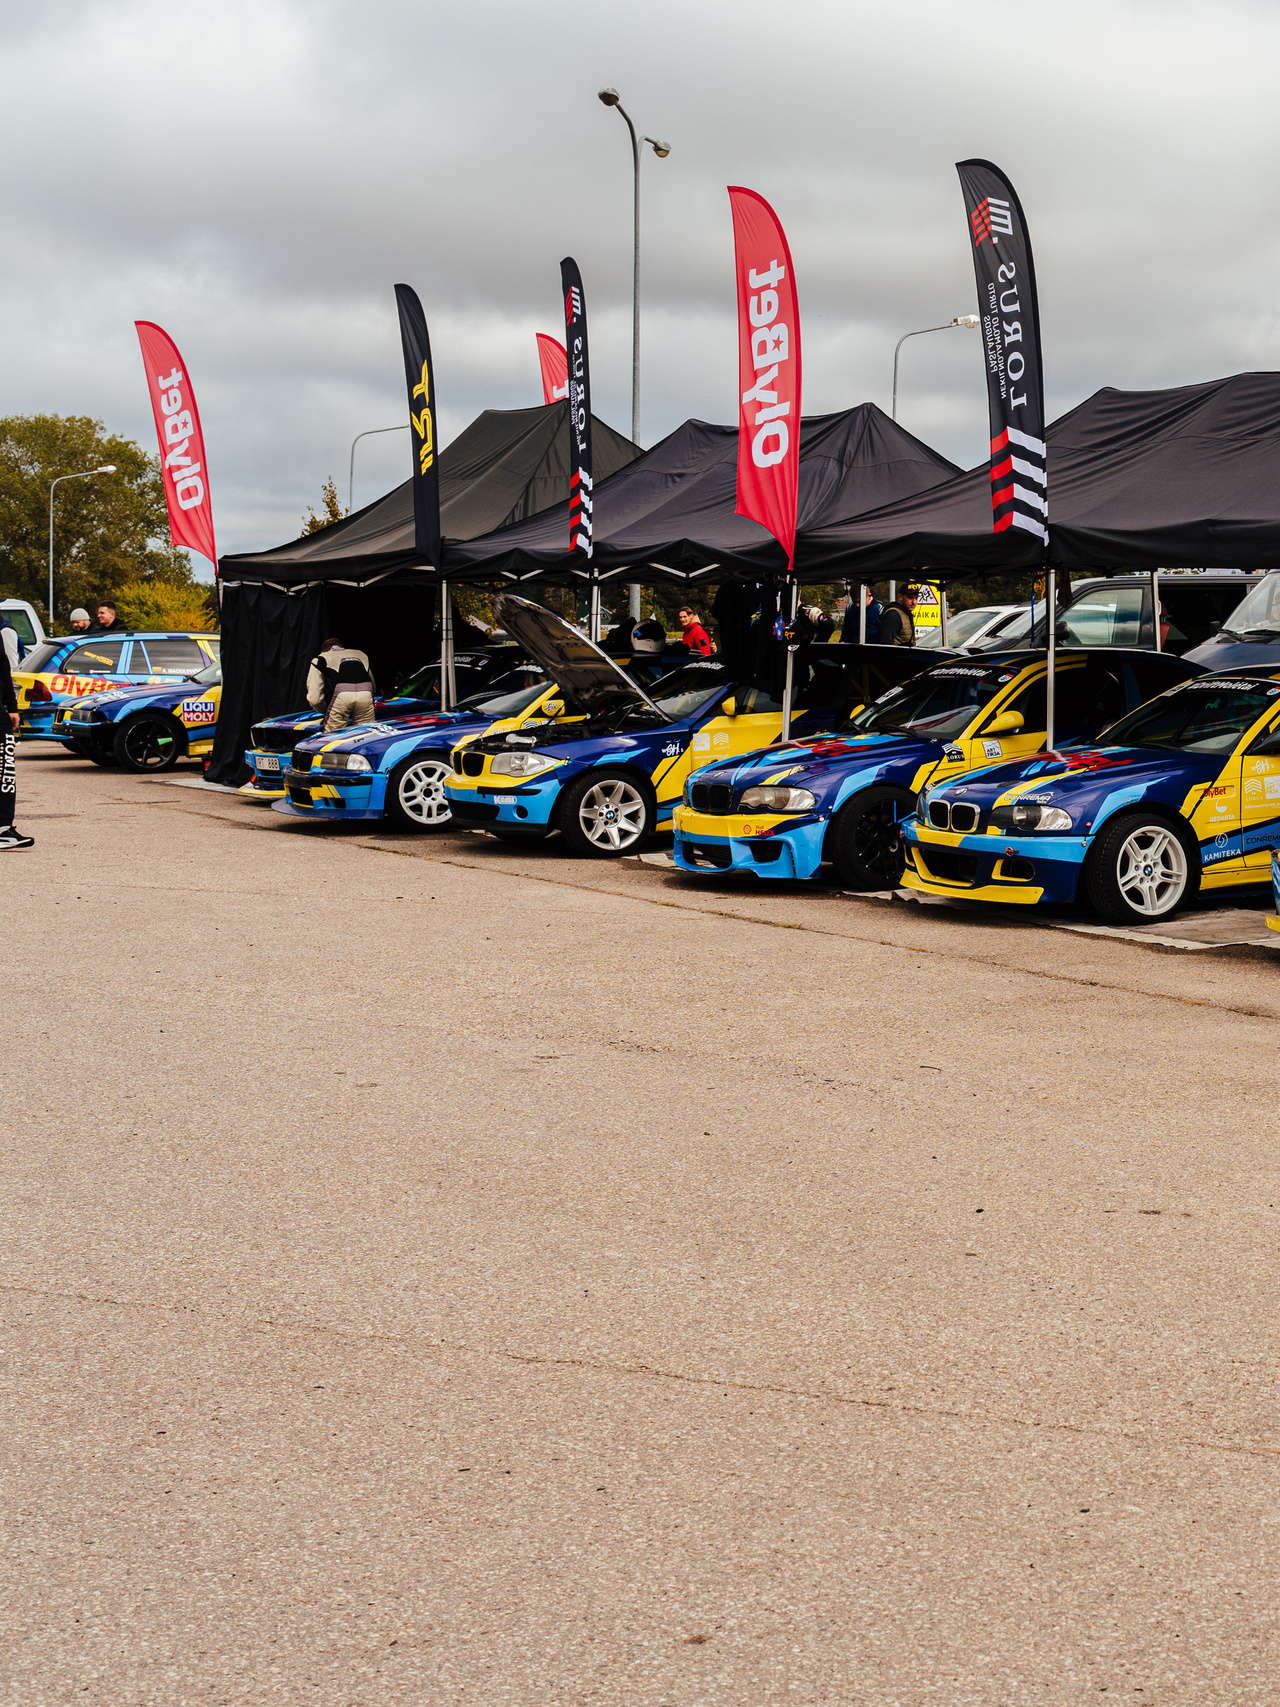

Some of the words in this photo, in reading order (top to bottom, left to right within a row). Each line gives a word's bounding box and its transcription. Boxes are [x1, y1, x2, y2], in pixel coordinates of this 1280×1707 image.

[182, 702, 214, 712] LIQUI
[183, 712, 215, 723] MOLY
[1209, 814, 1235, 823] GEDARTA
[1204, 848, 1242, 861] KAMITEKA
